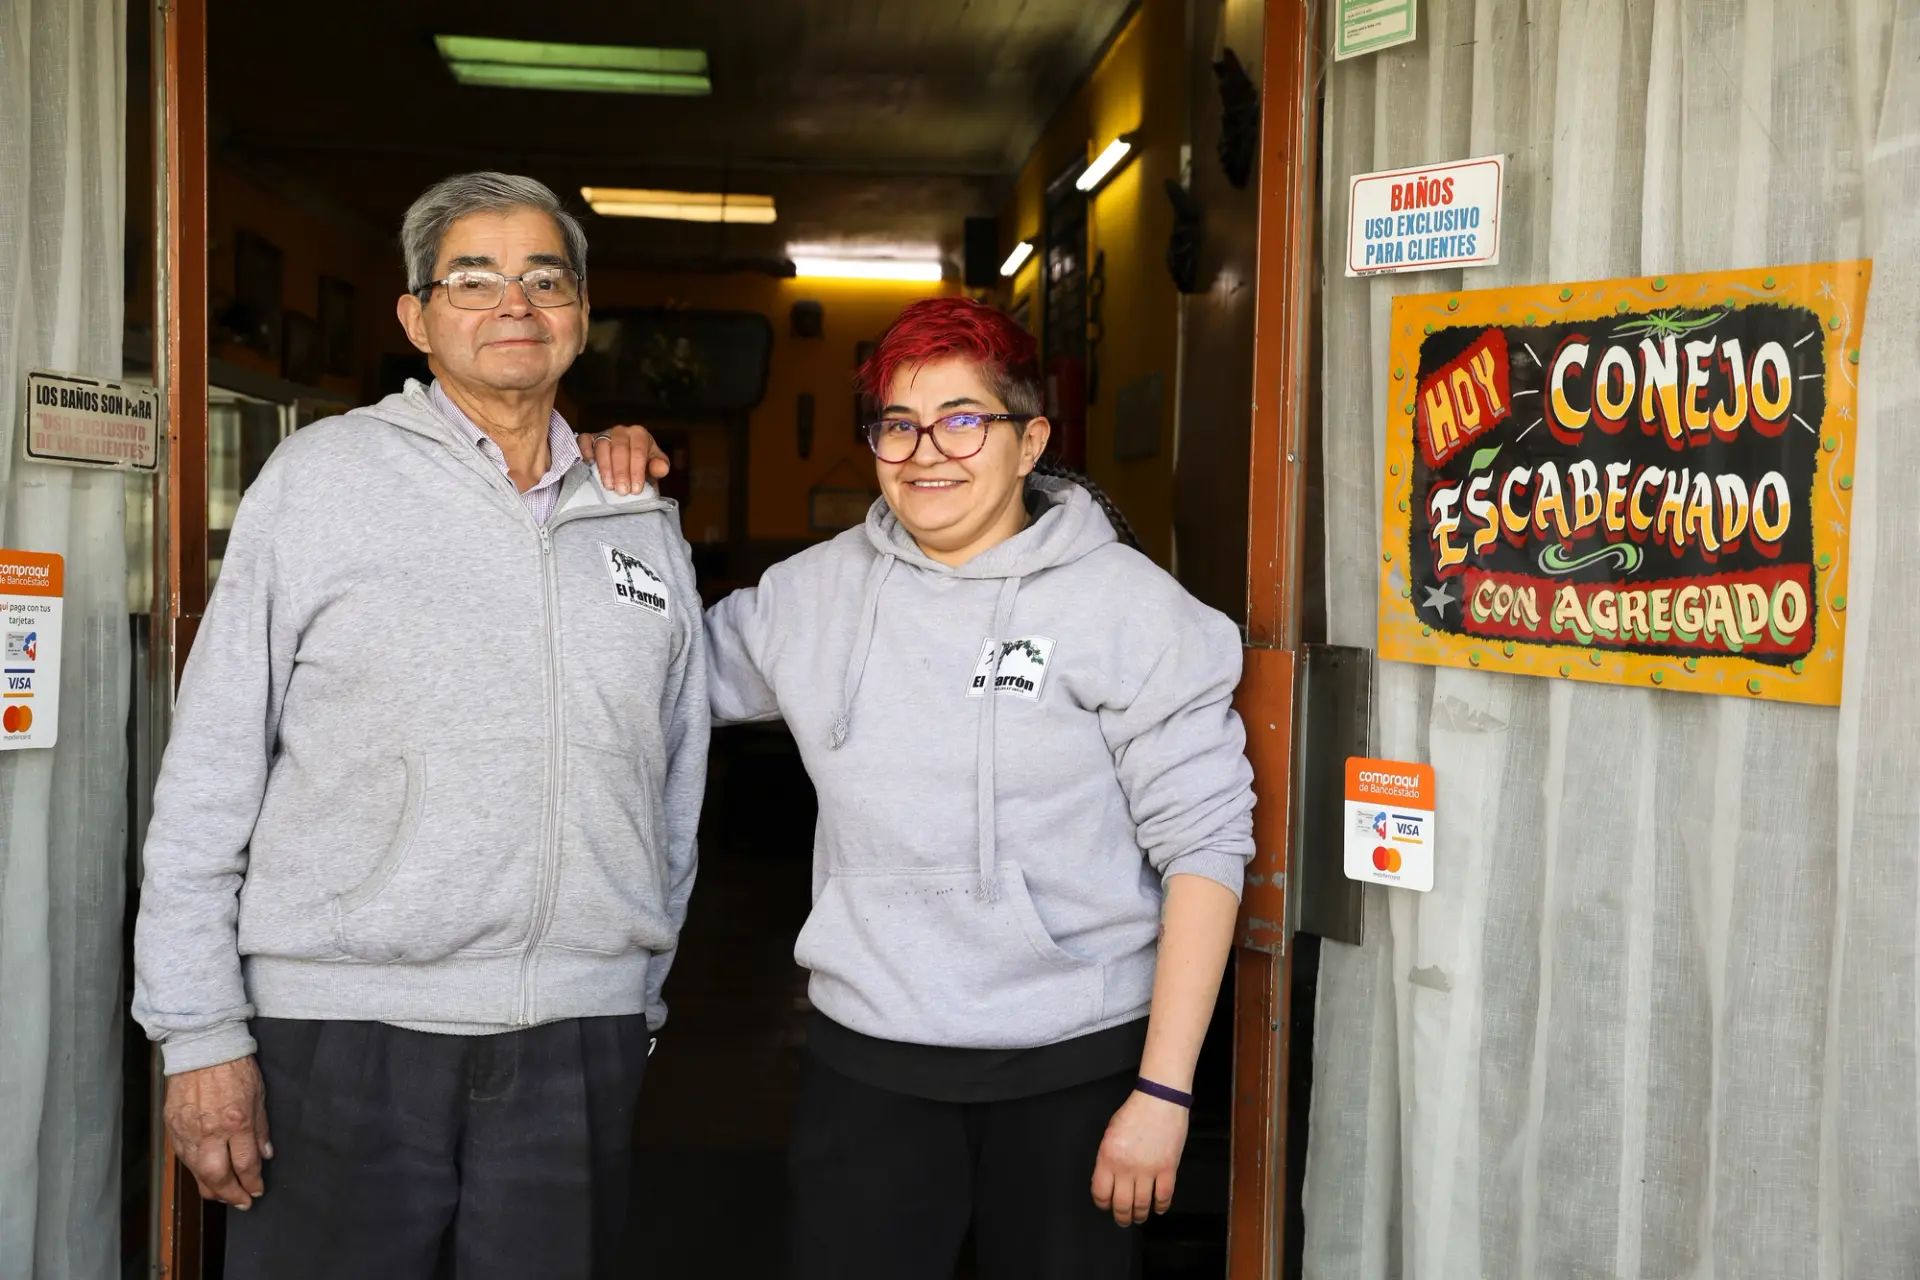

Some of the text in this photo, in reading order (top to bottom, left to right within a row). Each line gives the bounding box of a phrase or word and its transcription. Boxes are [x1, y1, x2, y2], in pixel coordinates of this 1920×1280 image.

[1391, 176, 1454, 211] BAÑOS
[1365, 206, 1480, 240] USO EXCLUSIVO
[1366, 234, 1476, 265] PARA CLIENTES
[36, 385, 152, 419] LOS BAÑOS SON PARA
[1424, 335, 1794, 457] HOY CONEJO
[76, 417, 146, 441] EXCLUSIVO
[1429, 458, 1793, 573] ESCABECHADO
[7, 576, 50, 587] BancoEstado
[616, 583, 628, 597] El
[628, 586, 666, 610] Parrón
[9, 604, 26, 614] paga
[27, 604, 40, 612] con
[40, 604, 51, 613] tus
[1469, 577, 1808, 646] CON AGREGADO
[9, 616, 35, 627] tarjetas
[8, 677, 31, 689] VISA
[972, 675, 986, 688] El
[995, 675, 1034, 692] arrón
[1359, 771, 1419, 788] compraquí
[1359, 783, 1420, 799] de BancoEstado
[1396, 822, 1420, 836] VISA
